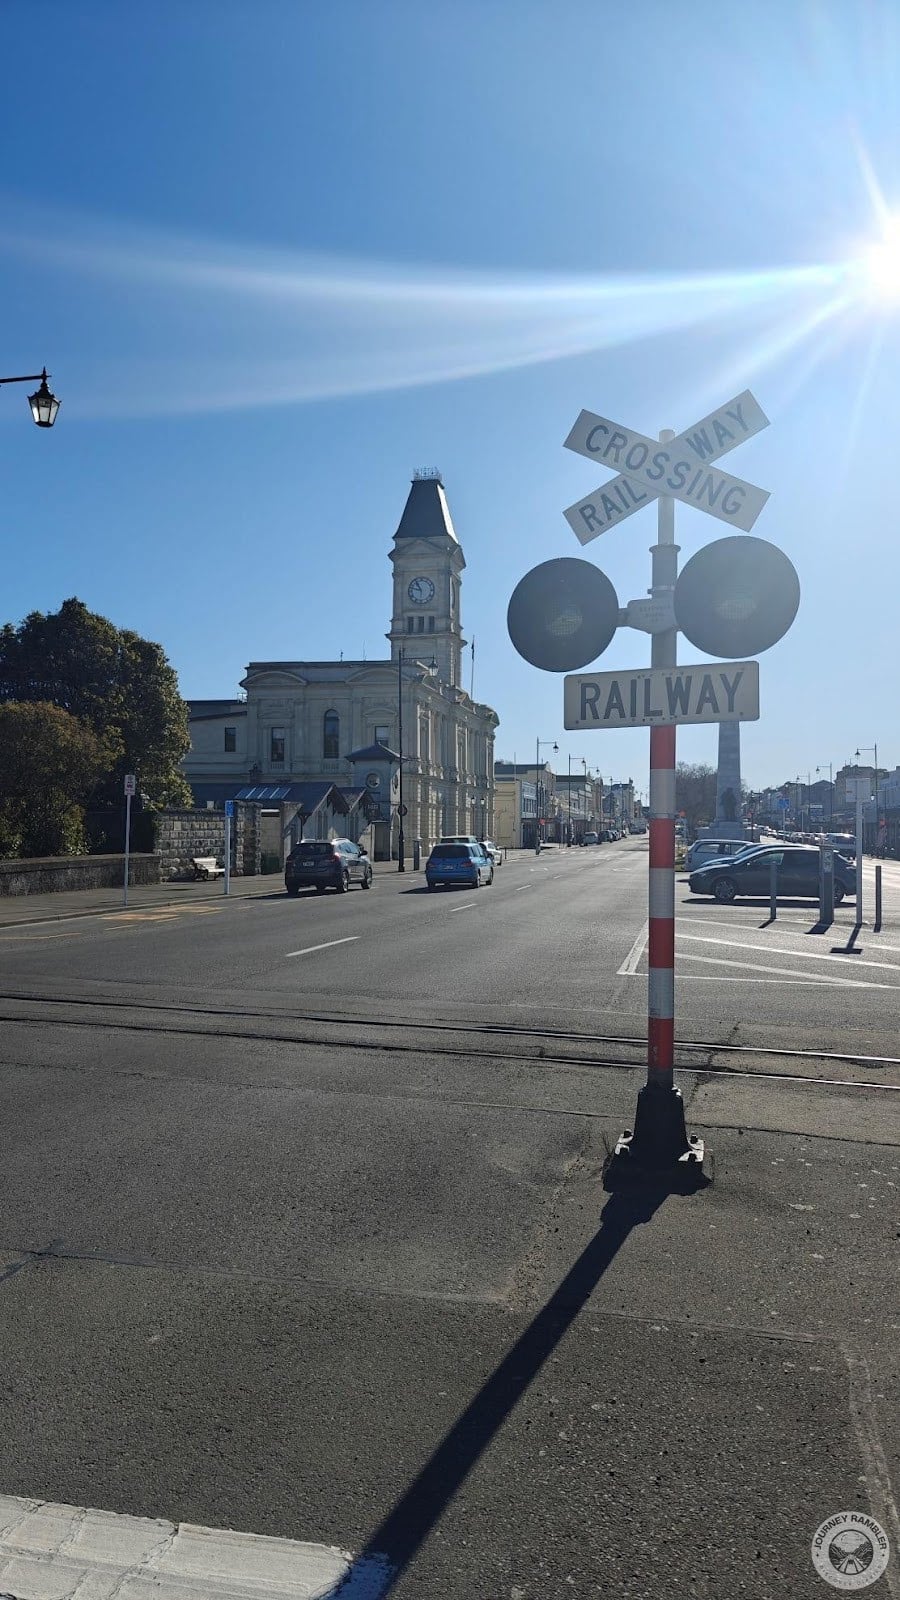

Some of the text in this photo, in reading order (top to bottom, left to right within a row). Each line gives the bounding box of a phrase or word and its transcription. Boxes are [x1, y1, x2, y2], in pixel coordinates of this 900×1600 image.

[579, 403, 749, 532] RAIL WAY
[585, 424, 747, 516] CROSSING
[580, 673, 744, 721] RAILWAY
